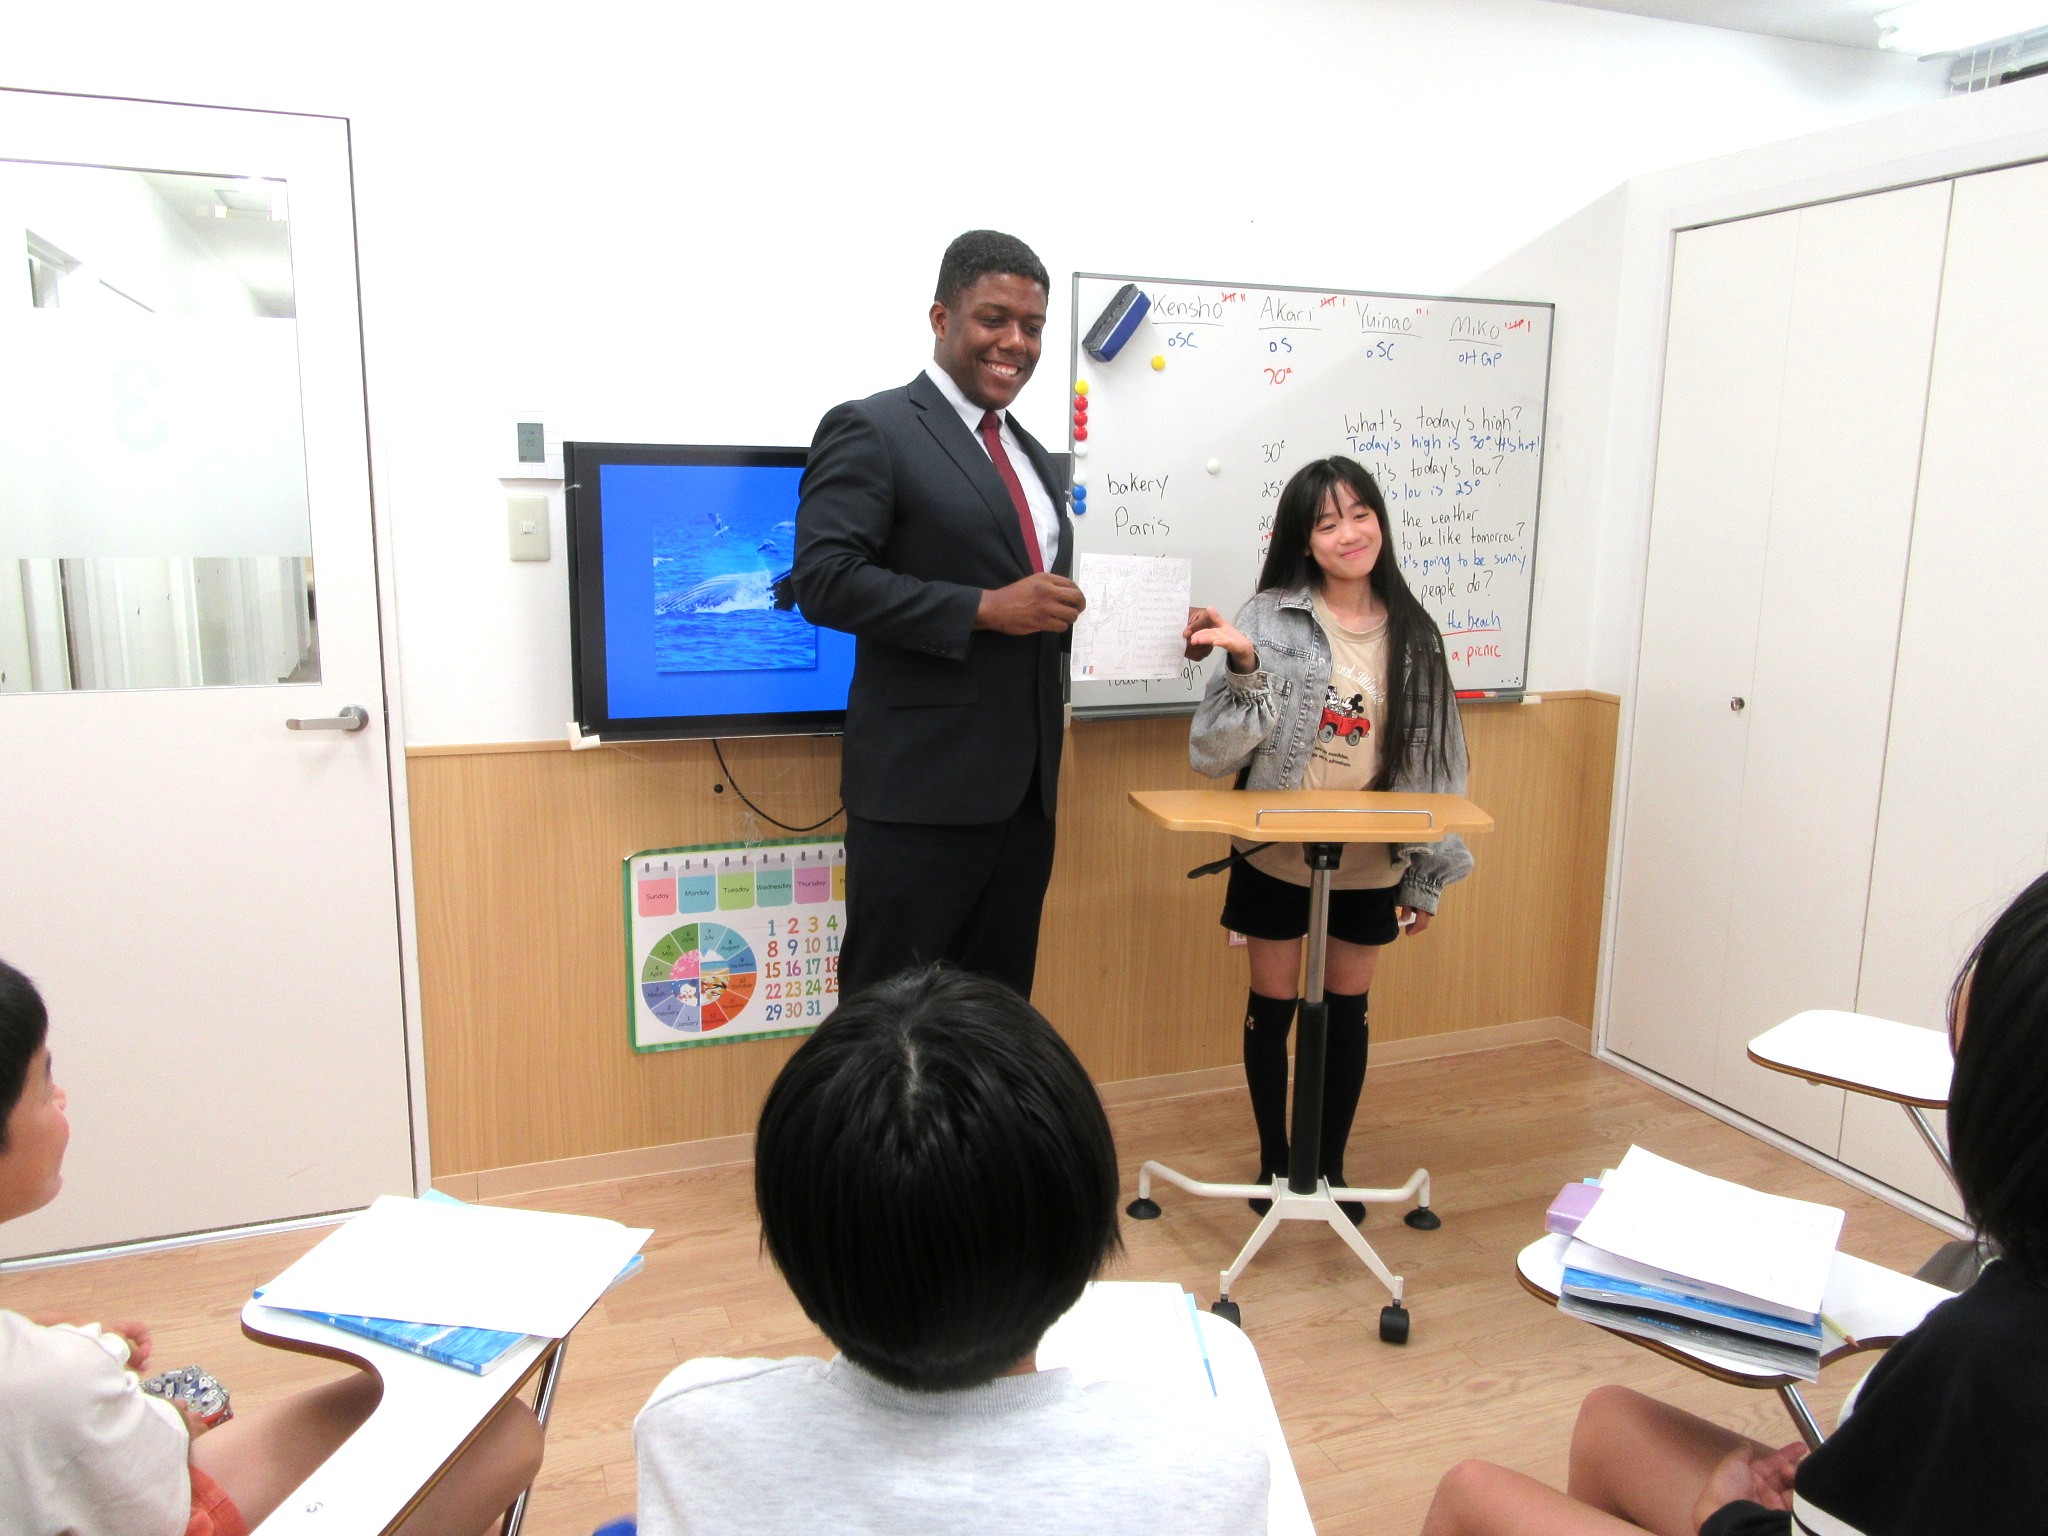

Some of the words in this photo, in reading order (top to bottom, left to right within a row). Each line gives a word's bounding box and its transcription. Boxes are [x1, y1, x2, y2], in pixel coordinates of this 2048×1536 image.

[1152, 294, 1223, 319] Kensho
[1260, 296, 1314, 322] Akari
[1451, 316, 1500, 340] Miko
[1344, 409, 1402, 434] What's
[1417, 406, 1475, 438] today's
[1482, 406, 1522, 442] high?
[1346, 434, 1401, 456] Today's
[1411, 434, 1441, 456] high
[1448, 436, 1460, 450] is
[1411, 457, 1461, 483] today's
[1472, 455, 1504, 487] low?
[1107, 473, 1169, 499] bakery
[1431, 486, 1443, 497] is
[1115, 506, 1170, 536] Paris
[1402, 509, 1423, 527] the
[1431, 503, 1479, 524] weather
[1402, 531, 1413, 550] to
[1419, 531, 1433, 547] be
[1438, 526, 1461, 547] like
[1423, 555, 1451, 576] going
[1458, 553, 1468, 567] to
[1473, 549, 1485, 566] be
[1494, 553, 1526, 576] sunny
[1420, 576, 1457, 608] people
[1467, 570, 1493, 597] do?
[1447, 609, 1463, 629] the
[1467, 609, 1501, 630] beach
[1451, 652, 1460, 661] a
[1467, 645, 1501, 667] picnic
[723, 886, 750, 894] Tuesday
[797, 880, 826, 888] Thursday
[768, 920, 776, 936] 1
[788, 918, 799, 934] 2
[808, 916, 819, 933] 3
[826, 914, 838, 931] 4
[767, 940, 778, 958] 8
[788, 939, 798, 956] 9
[805, 937, 821, 954] 10
[826, 936, 839, 952] 11
[765, 962, 781, 979] 15
[786, 960, 802, 977] 16
[806, 958, 821, 975] 17
[825, 956, 839, 973] 18
[766, 983, 782, 1000] 22
[785, 981, 802, 998] 23
[806, 979, 822, 996] 24
[825, 977, 840, 994] 25
[766, 1004, 782, 1021] 29
[785, 1002, 802, 1018] 30
[806, 1000, 822, 1016] 31
